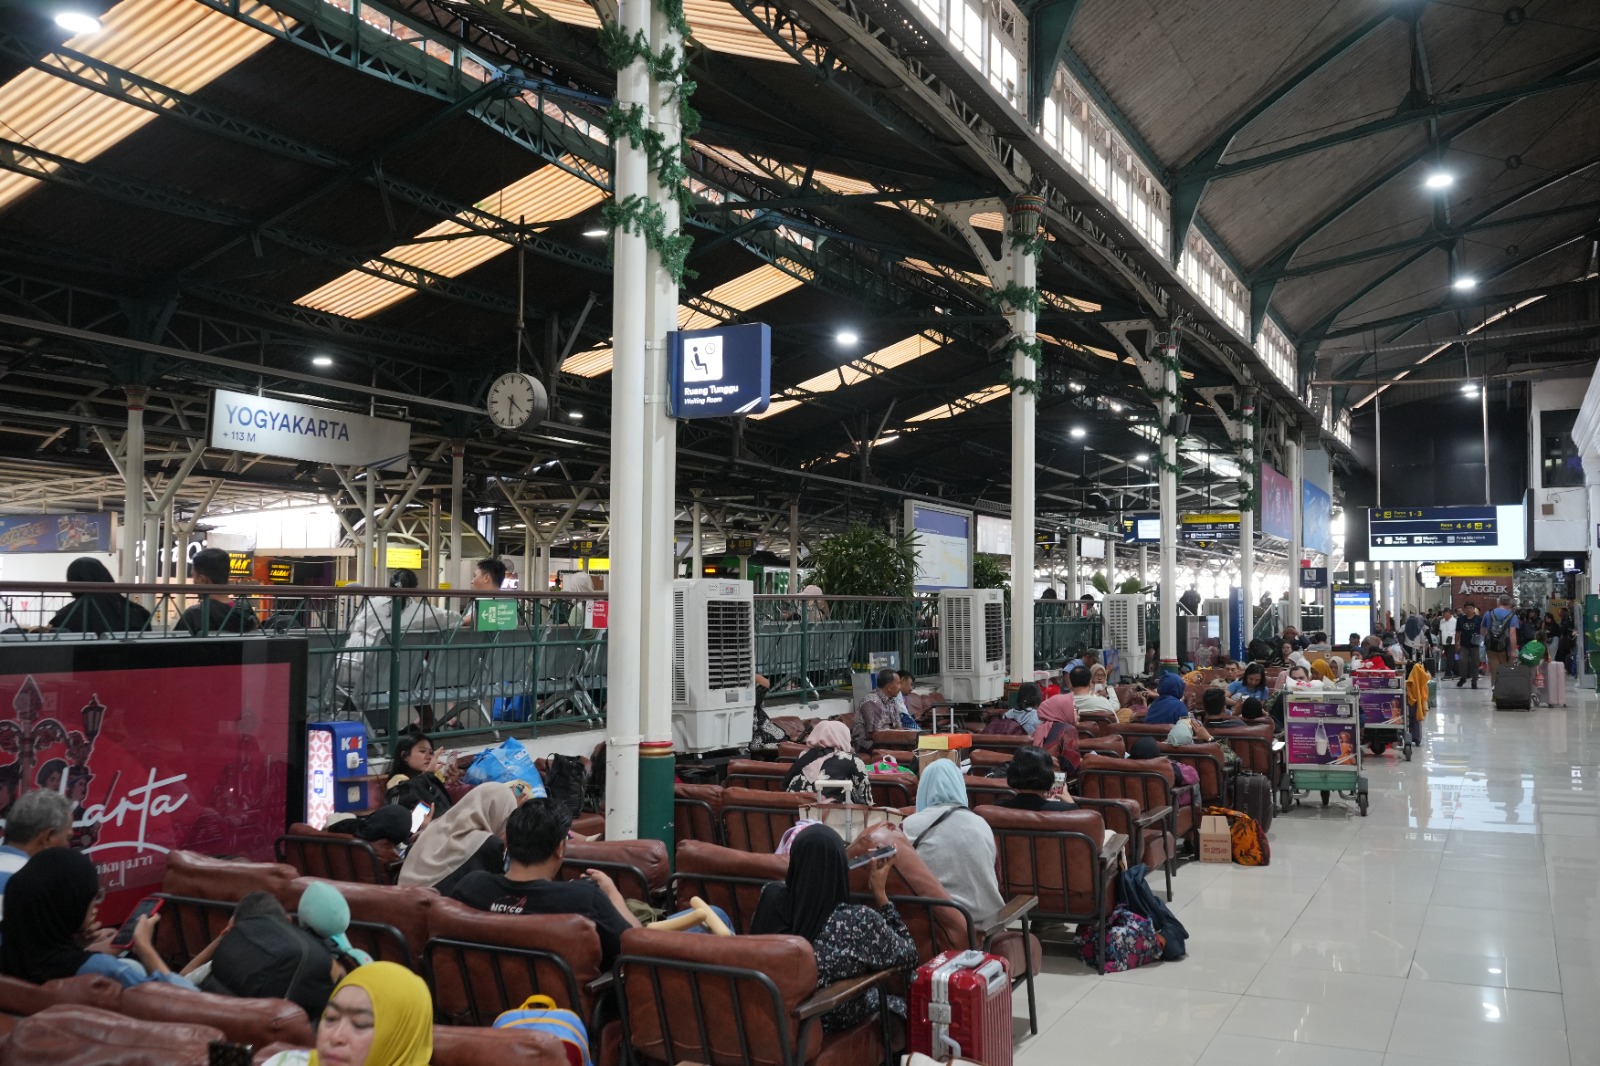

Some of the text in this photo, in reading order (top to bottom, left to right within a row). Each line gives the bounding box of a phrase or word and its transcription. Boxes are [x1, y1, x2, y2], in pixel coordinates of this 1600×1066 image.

[684, 385, 739, 396] Ruang Tunggu
[226, 404, 349, 441] YOGYAKARTA
[232, 431, 245, 441] 113
[247, 433, 256, 442] M
[1458, 580, 1508, 595] ANGGREK
[341, 735, 363, 750] KAI
